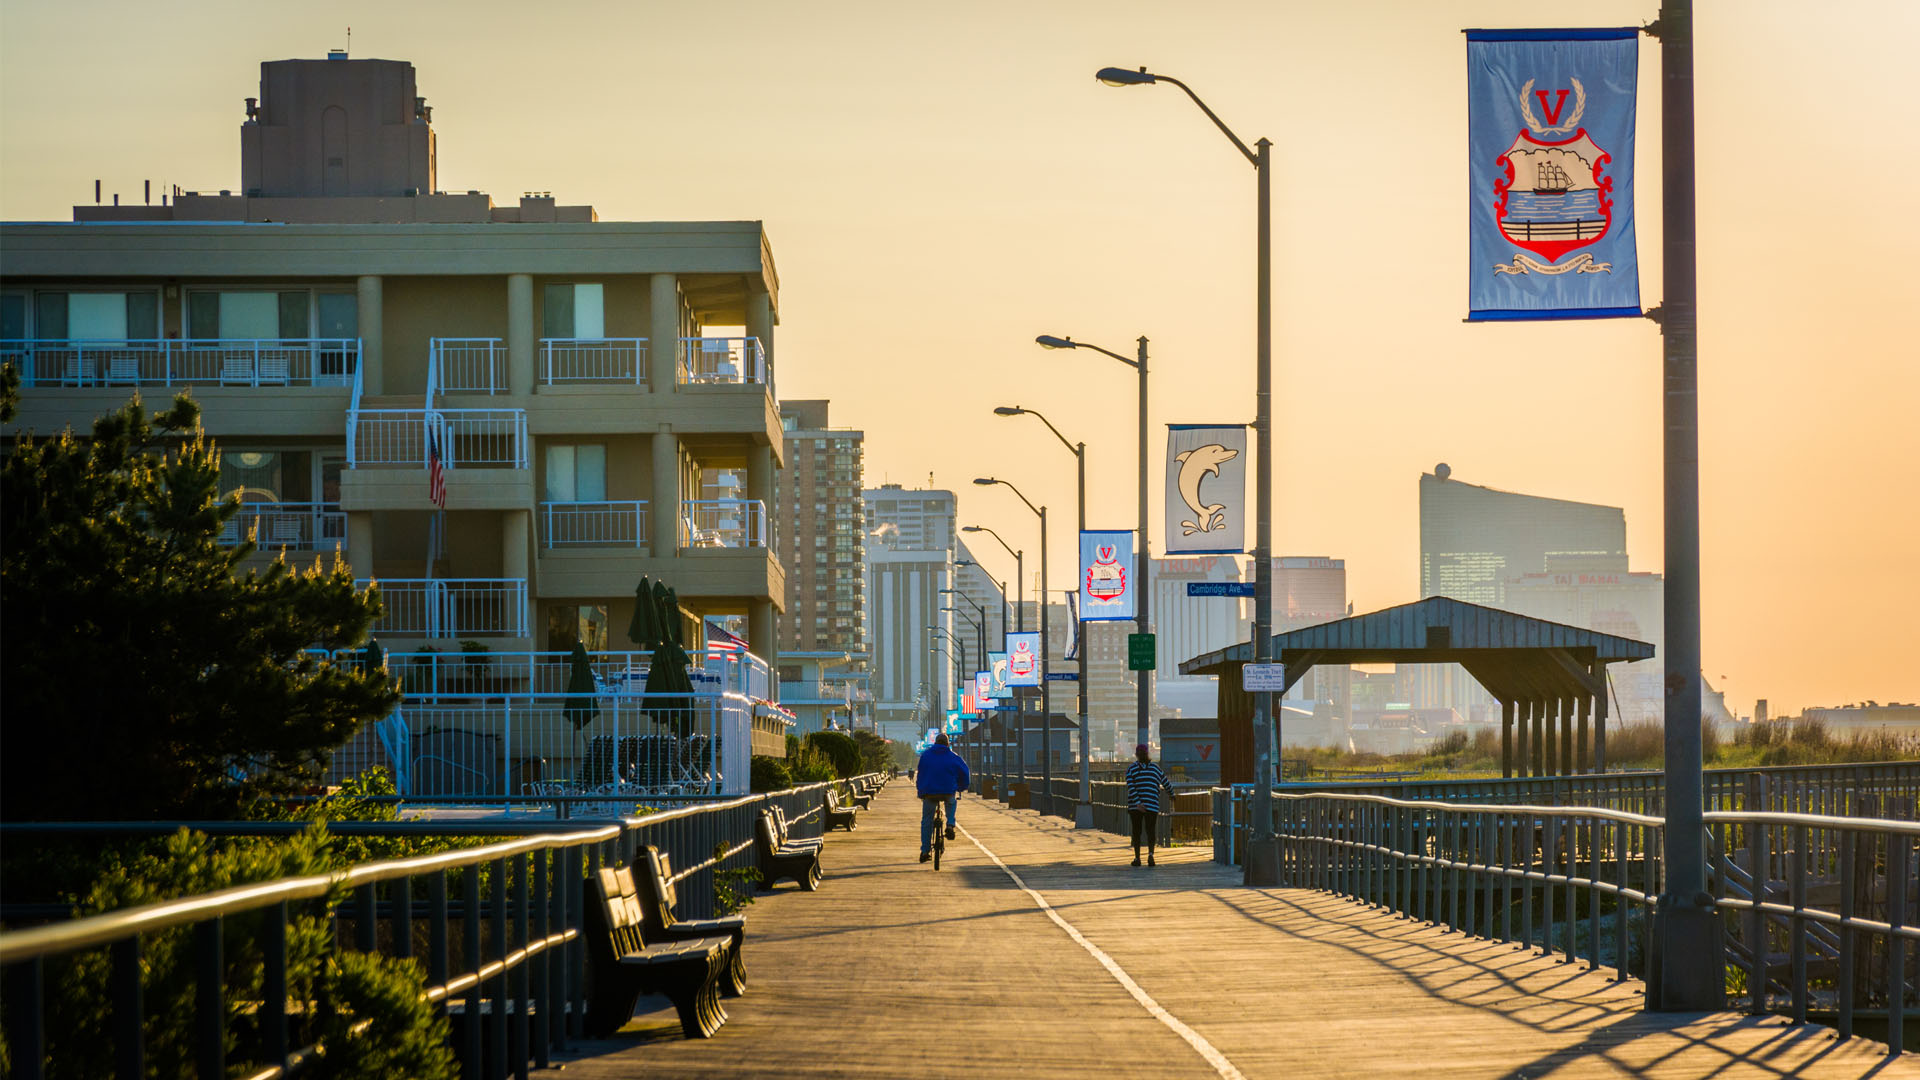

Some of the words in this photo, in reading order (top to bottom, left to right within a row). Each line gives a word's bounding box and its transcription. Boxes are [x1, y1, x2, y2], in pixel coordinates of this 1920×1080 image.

[1536, 89, 1570, 125] V
[1100, 548, 1112, 559] V
[1158, 558, 1217, 573] TRUMP
[1190, 584, 1227, 595] Cambridge
[1229, 584, 1243, 593] Ave.
